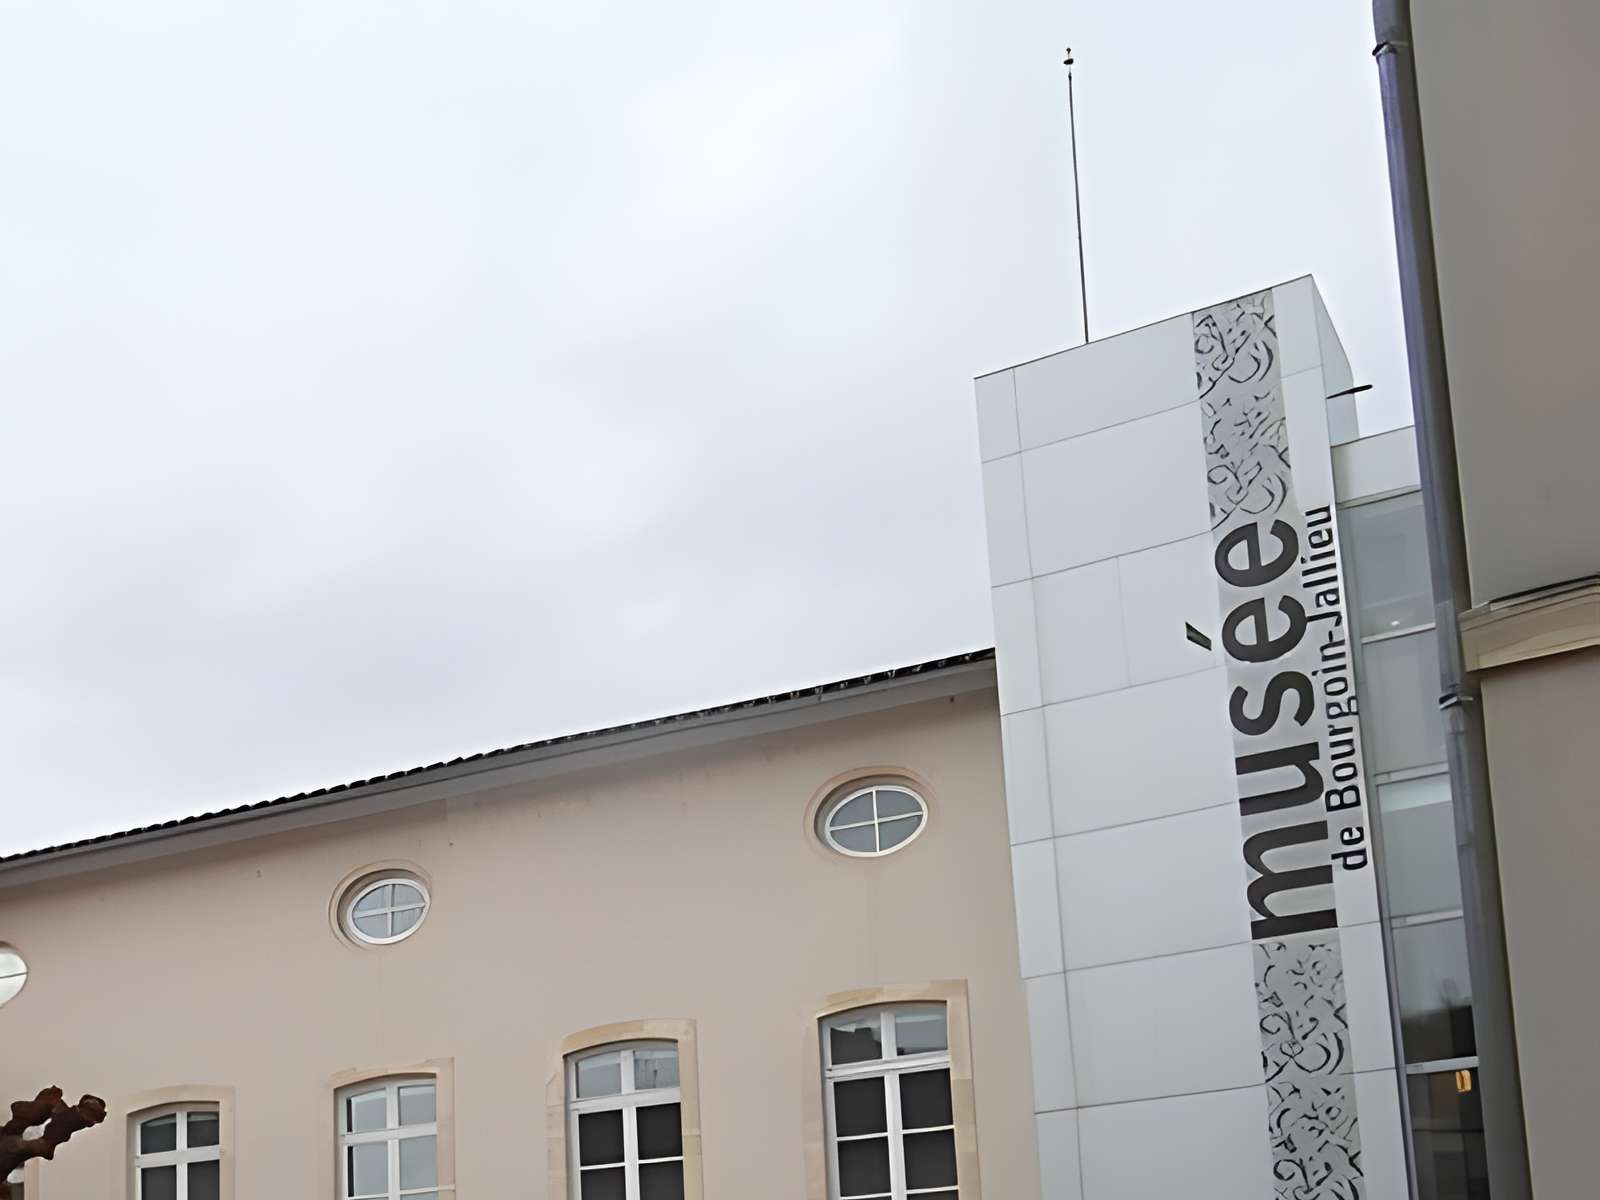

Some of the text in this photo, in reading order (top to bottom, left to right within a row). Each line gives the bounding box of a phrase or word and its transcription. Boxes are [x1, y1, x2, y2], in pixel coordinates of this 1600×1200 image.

[1185, 519, 1338, 940] musée
[1300, 505, 1368, 870] de Bourgoin-Jallieu
